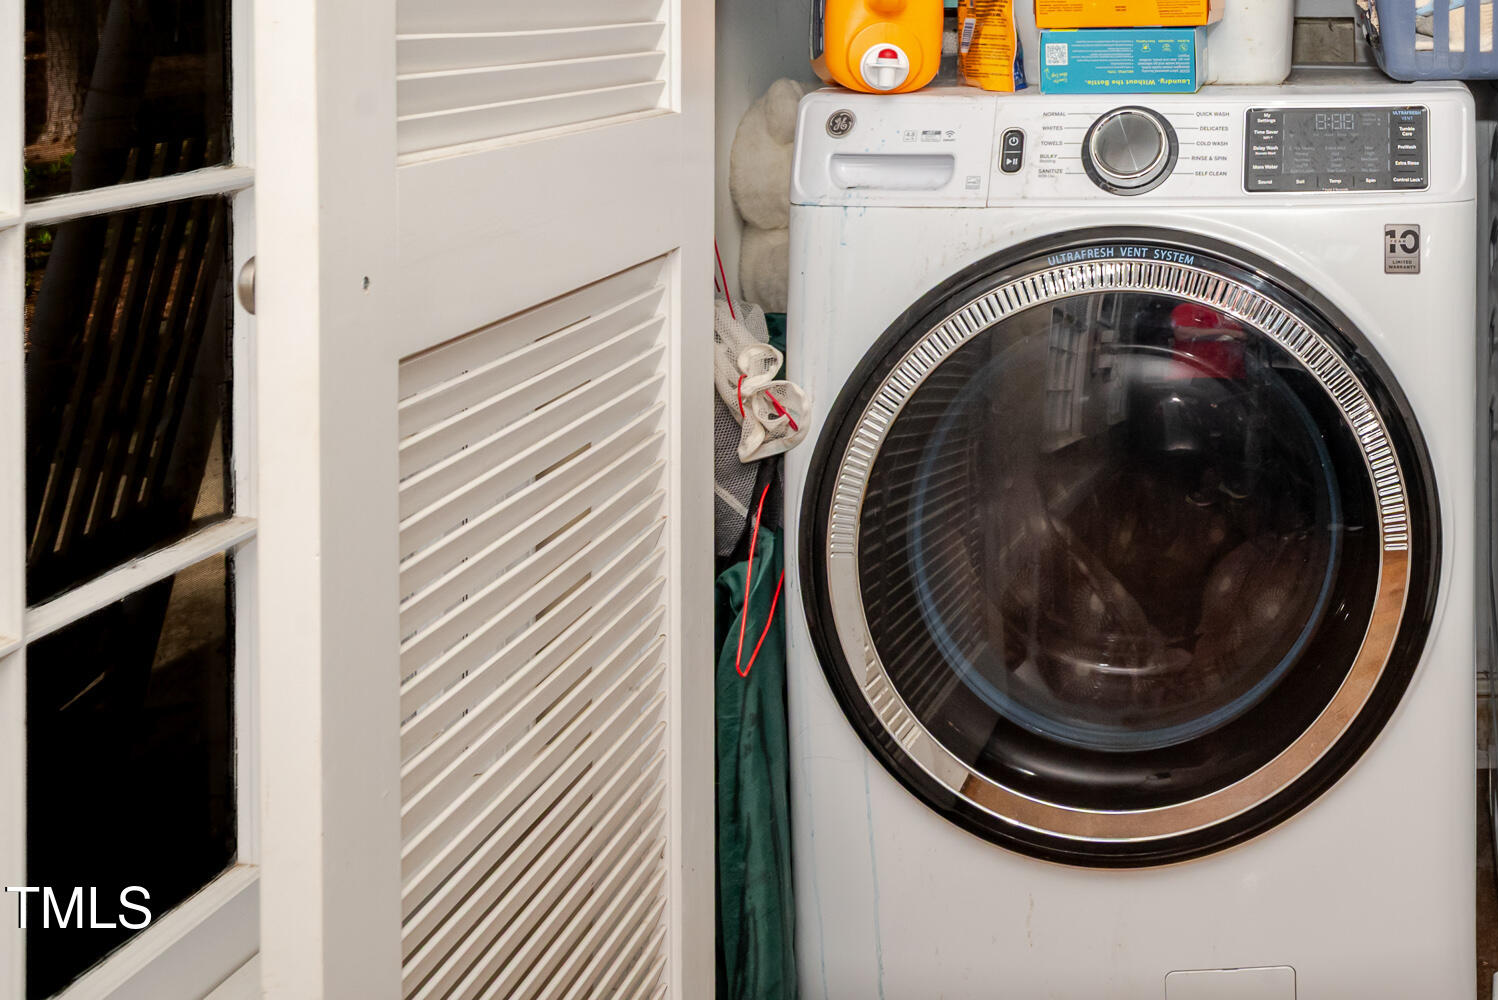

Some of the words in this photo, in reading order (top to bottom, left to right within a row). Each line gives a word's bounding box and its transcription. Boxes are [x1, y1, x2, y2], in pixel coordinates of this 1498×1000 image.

[1385, 229, 1420, 254] 10
[1047, 247, 1114, 266] ULTRAFRESH
[1120, 247, 1148, 258] VENT
[1153, 249, 1195, 265] SYSTEM
